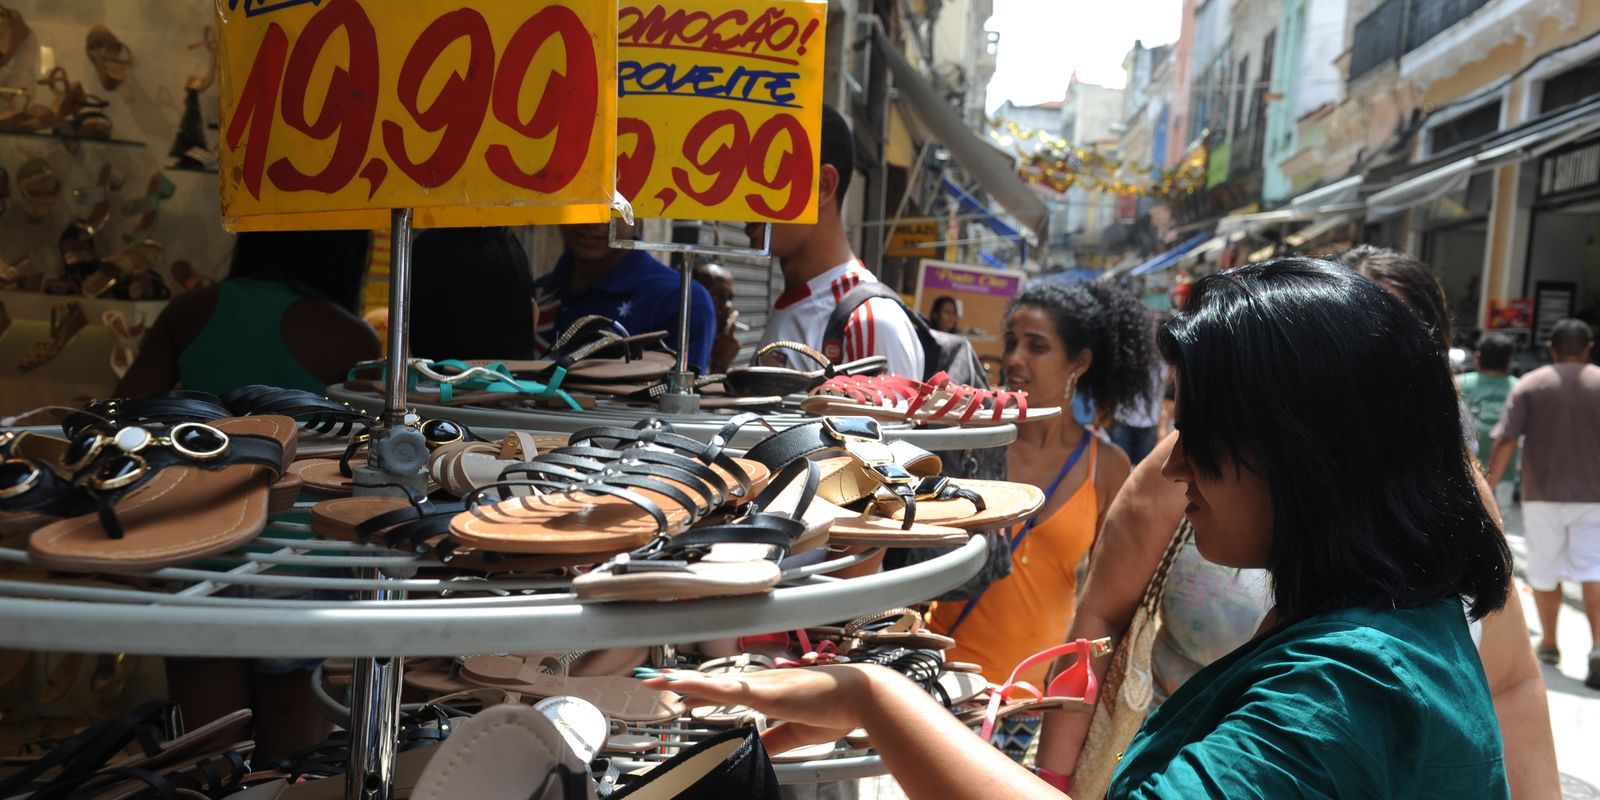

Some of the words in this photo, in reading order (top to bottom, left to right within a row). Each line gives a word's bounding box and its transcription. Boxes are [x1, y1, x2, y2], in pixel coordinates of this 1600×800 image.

[618, 4, 820, 56] OMOÇÃO!
[226, 0, 598, 201] 19,99
[617, 108, 814, 220] 9,99
